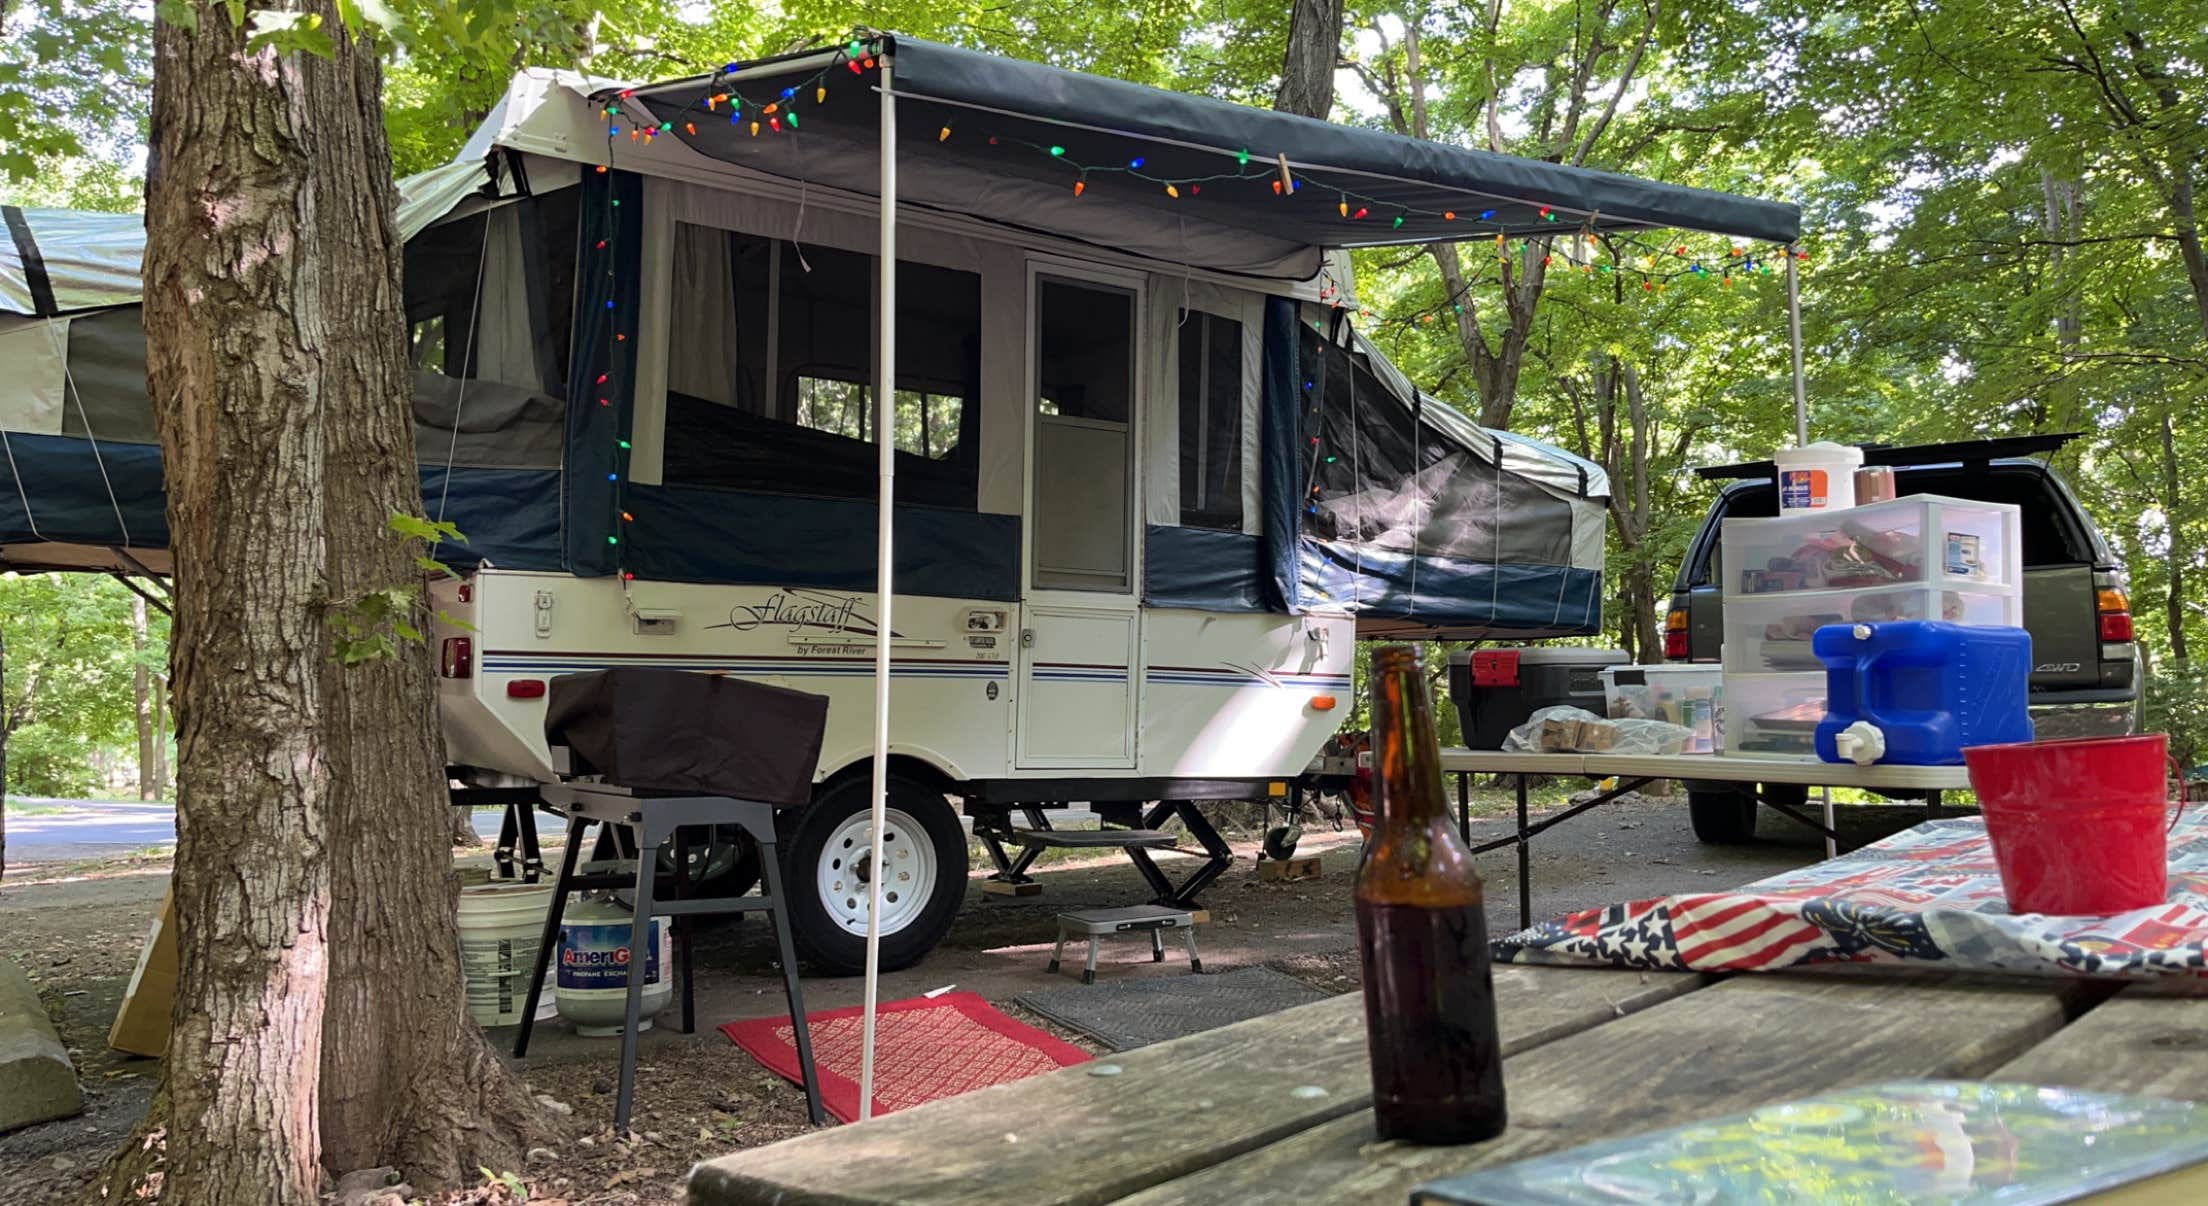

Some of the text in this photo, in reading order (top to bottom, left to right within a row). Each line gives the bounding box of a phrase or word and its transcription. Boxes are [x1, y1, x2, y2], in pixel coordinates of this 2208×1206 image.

[797, 645, 866, 655] by Forest River
[563, 947, 631, 966] AmeriG
